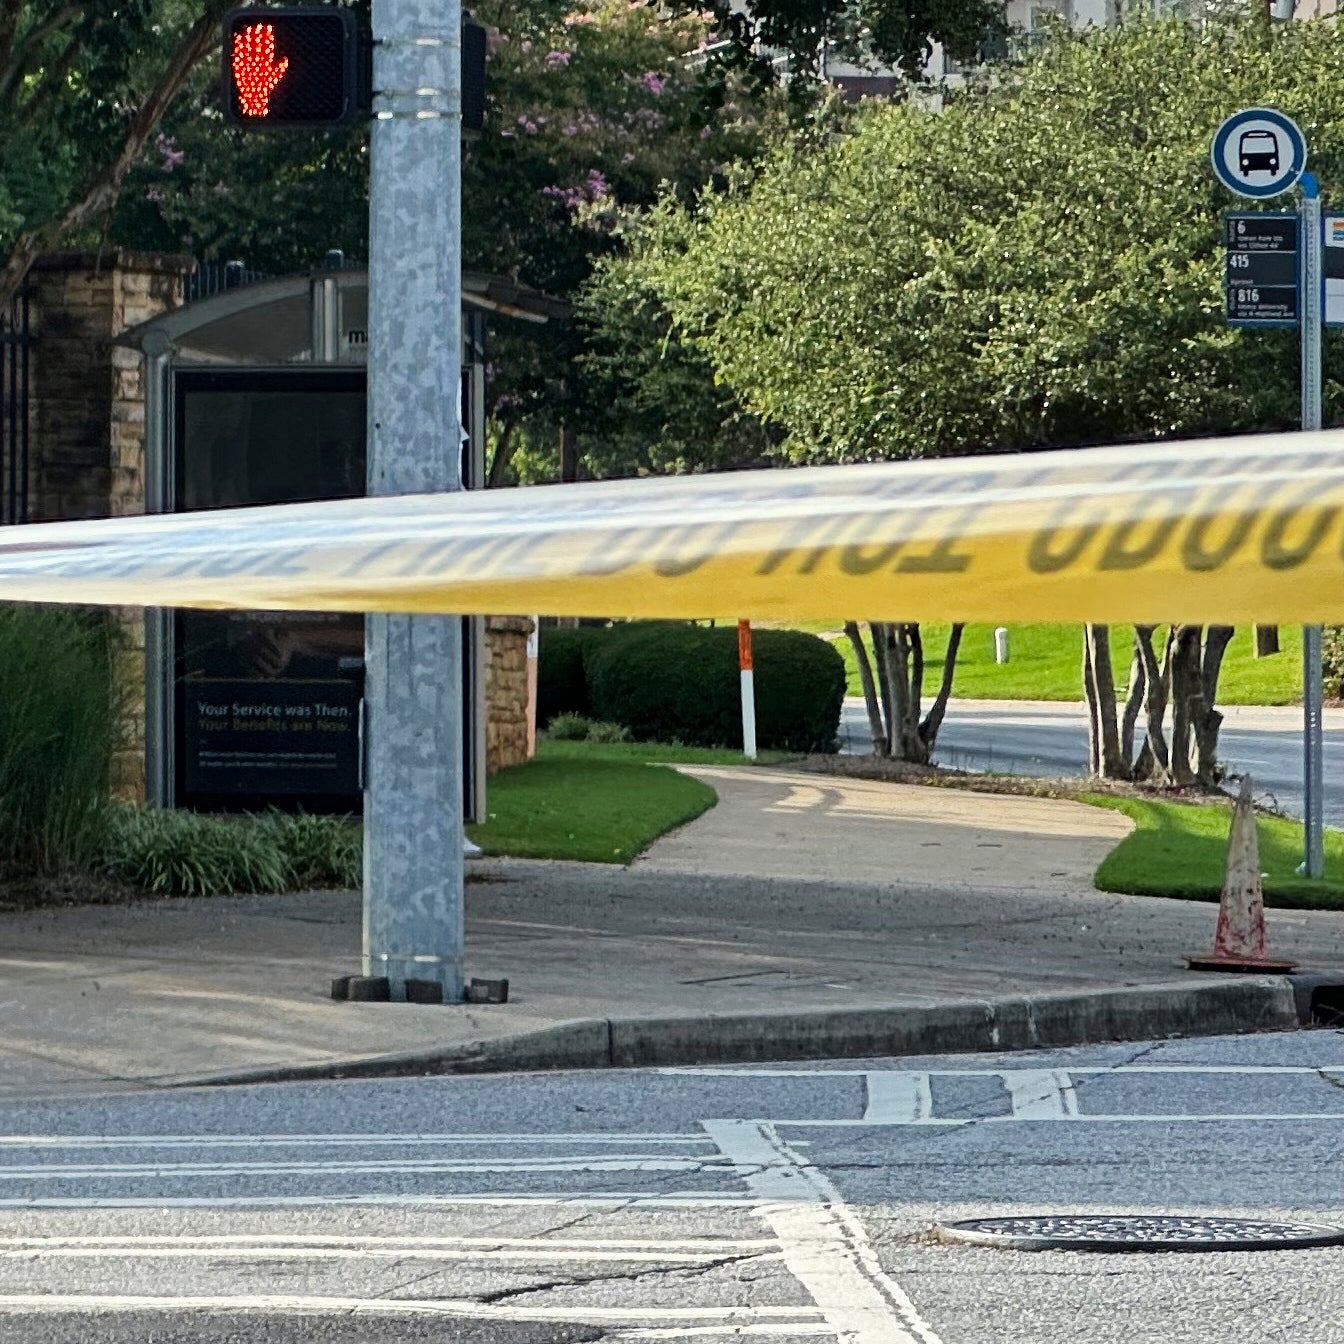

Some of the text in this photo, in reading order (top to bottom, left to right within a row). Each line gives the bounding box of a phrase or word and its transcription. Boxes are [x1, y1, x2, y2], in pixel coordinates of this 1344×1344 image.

[1237, 220, 1246, 234] 6
[1230, 254, 1250, 269] 415
[1238, 288, 1260, 302] 816
[198, 701, 353, 716] Your Service was Then.
